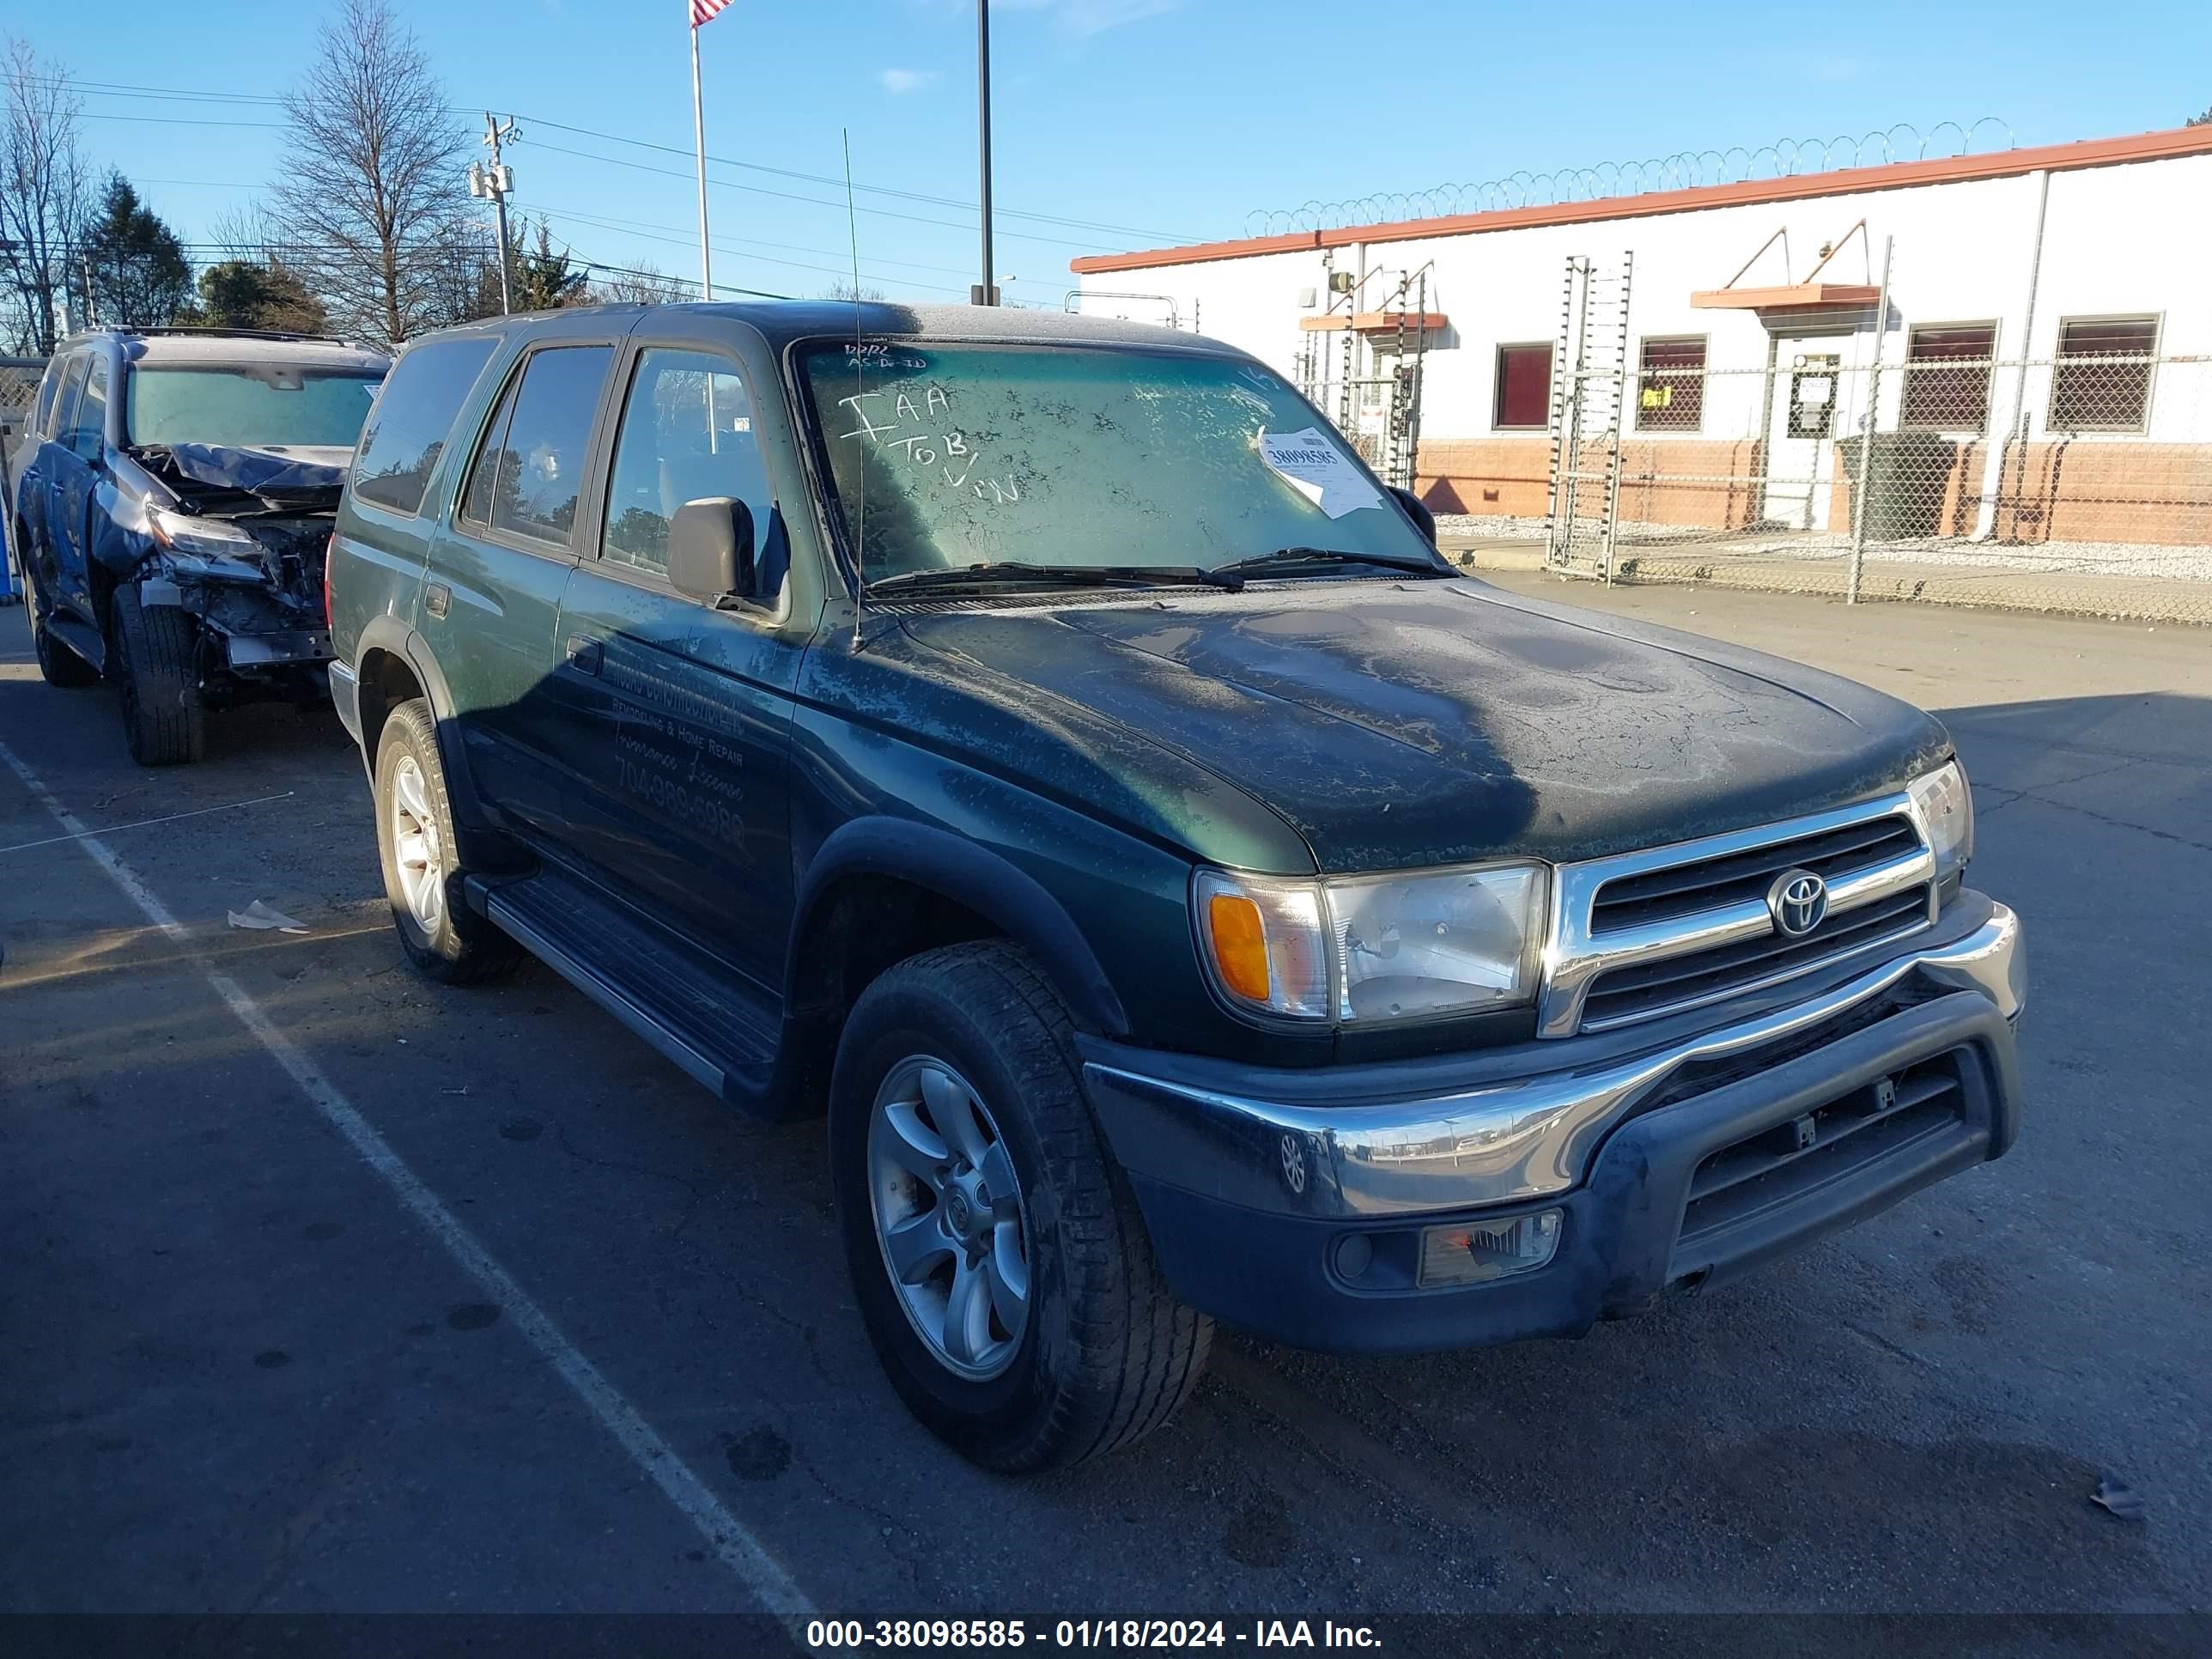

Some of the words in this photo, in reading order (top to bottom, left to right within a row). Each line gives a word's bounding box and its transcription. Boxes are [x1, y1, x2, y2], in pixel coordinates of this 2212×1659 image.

[838, 386, 950, 442] IAA
[942, 432, 968, 457] B
[1267, 450, 1338, 465] 38098585
[611, 697, 663, 732] REMODELING
[667, 720, 675, 737] &
[678, 726, 704, 750] HOME
[708, 738, 743, 768] REPAIR
